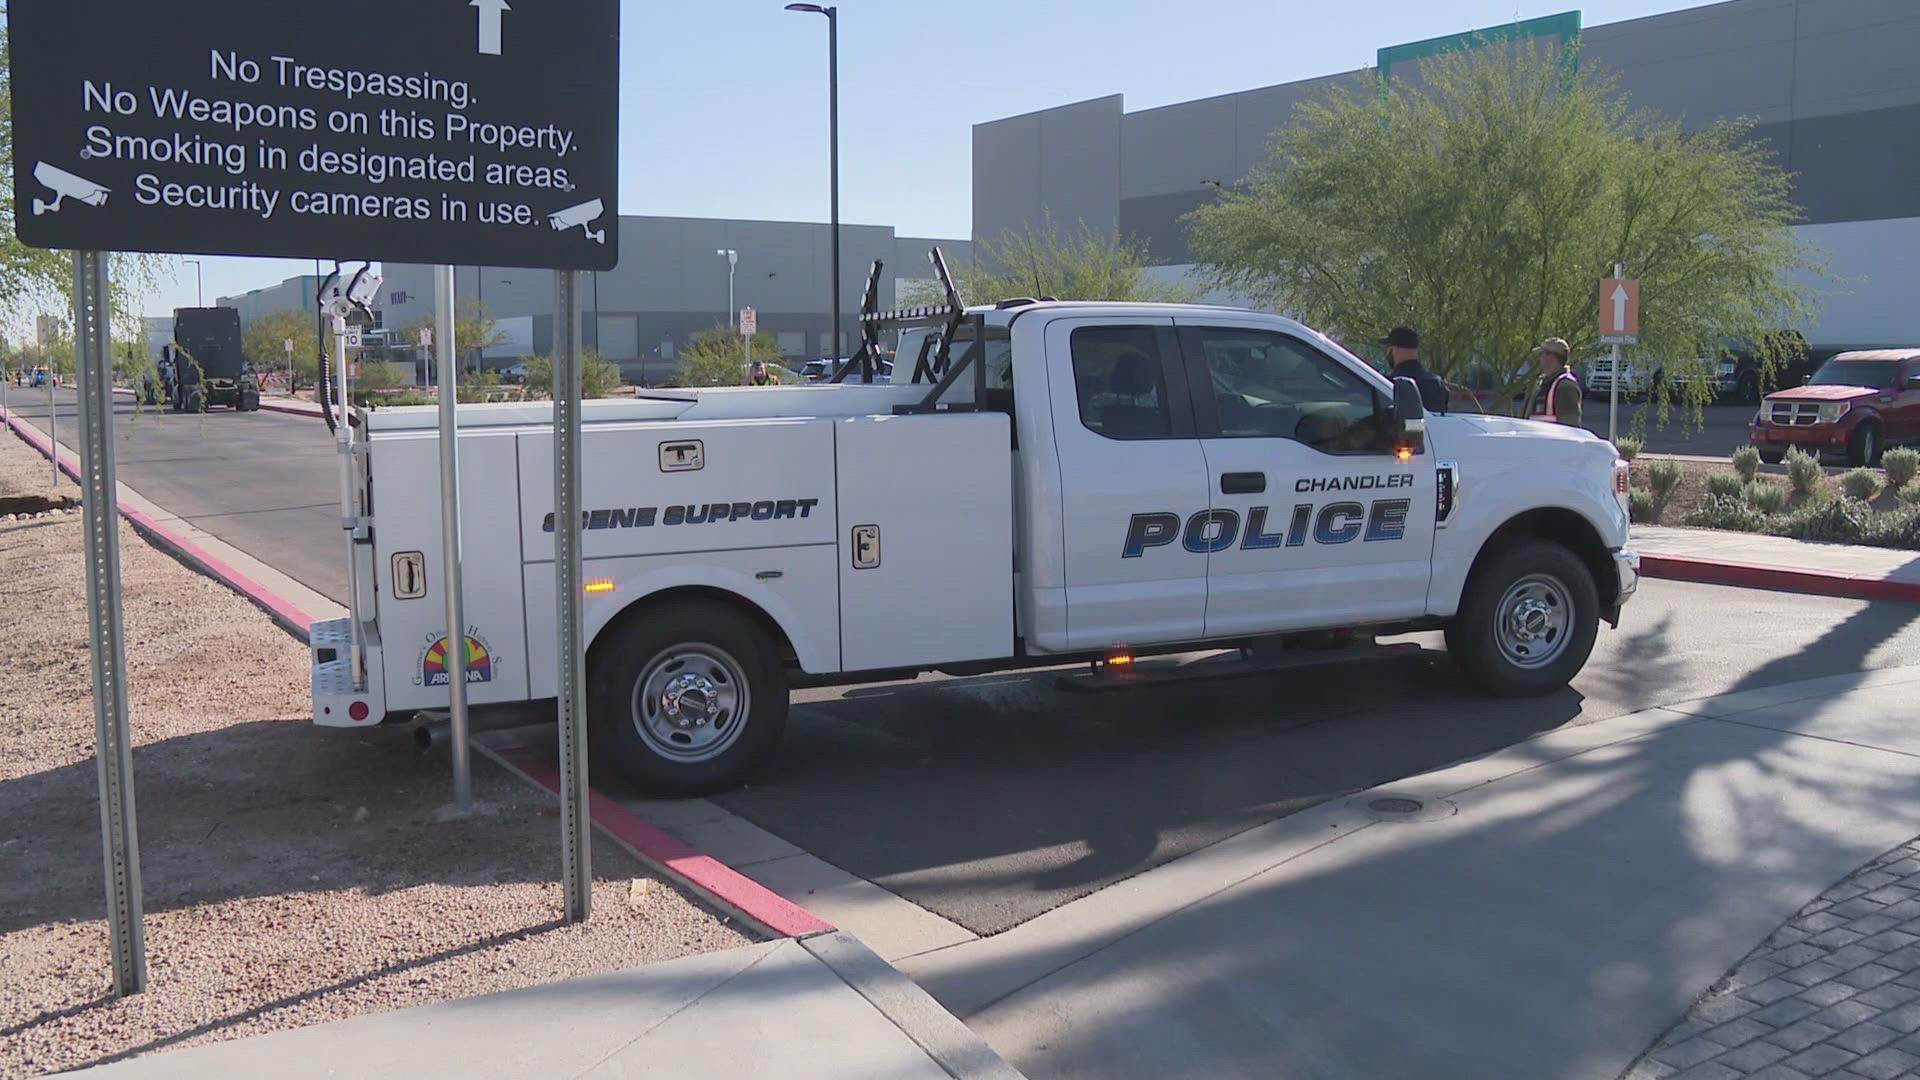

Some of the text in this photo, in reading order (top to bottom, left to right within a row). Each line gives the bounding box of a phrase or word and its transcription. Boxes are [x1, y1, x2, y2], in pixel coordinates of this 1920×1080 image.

[210, 50, 478, 109] No Trespassing.
[82, 80, 578, 157] No Weapons on this Property.
[86, 126, 577, 191] Smoking in designated areas.
[134, 174, 540, 226] Security cameras in use.
[346, 335, 358, 345] 10
[1295, 474, 1414, 493] CHANDLER
[542, 499, 818, 533] SENE SUPPORT
[1121, 498, 1411, 559] POLICE
[430, 670, 484, 684] ARNA
